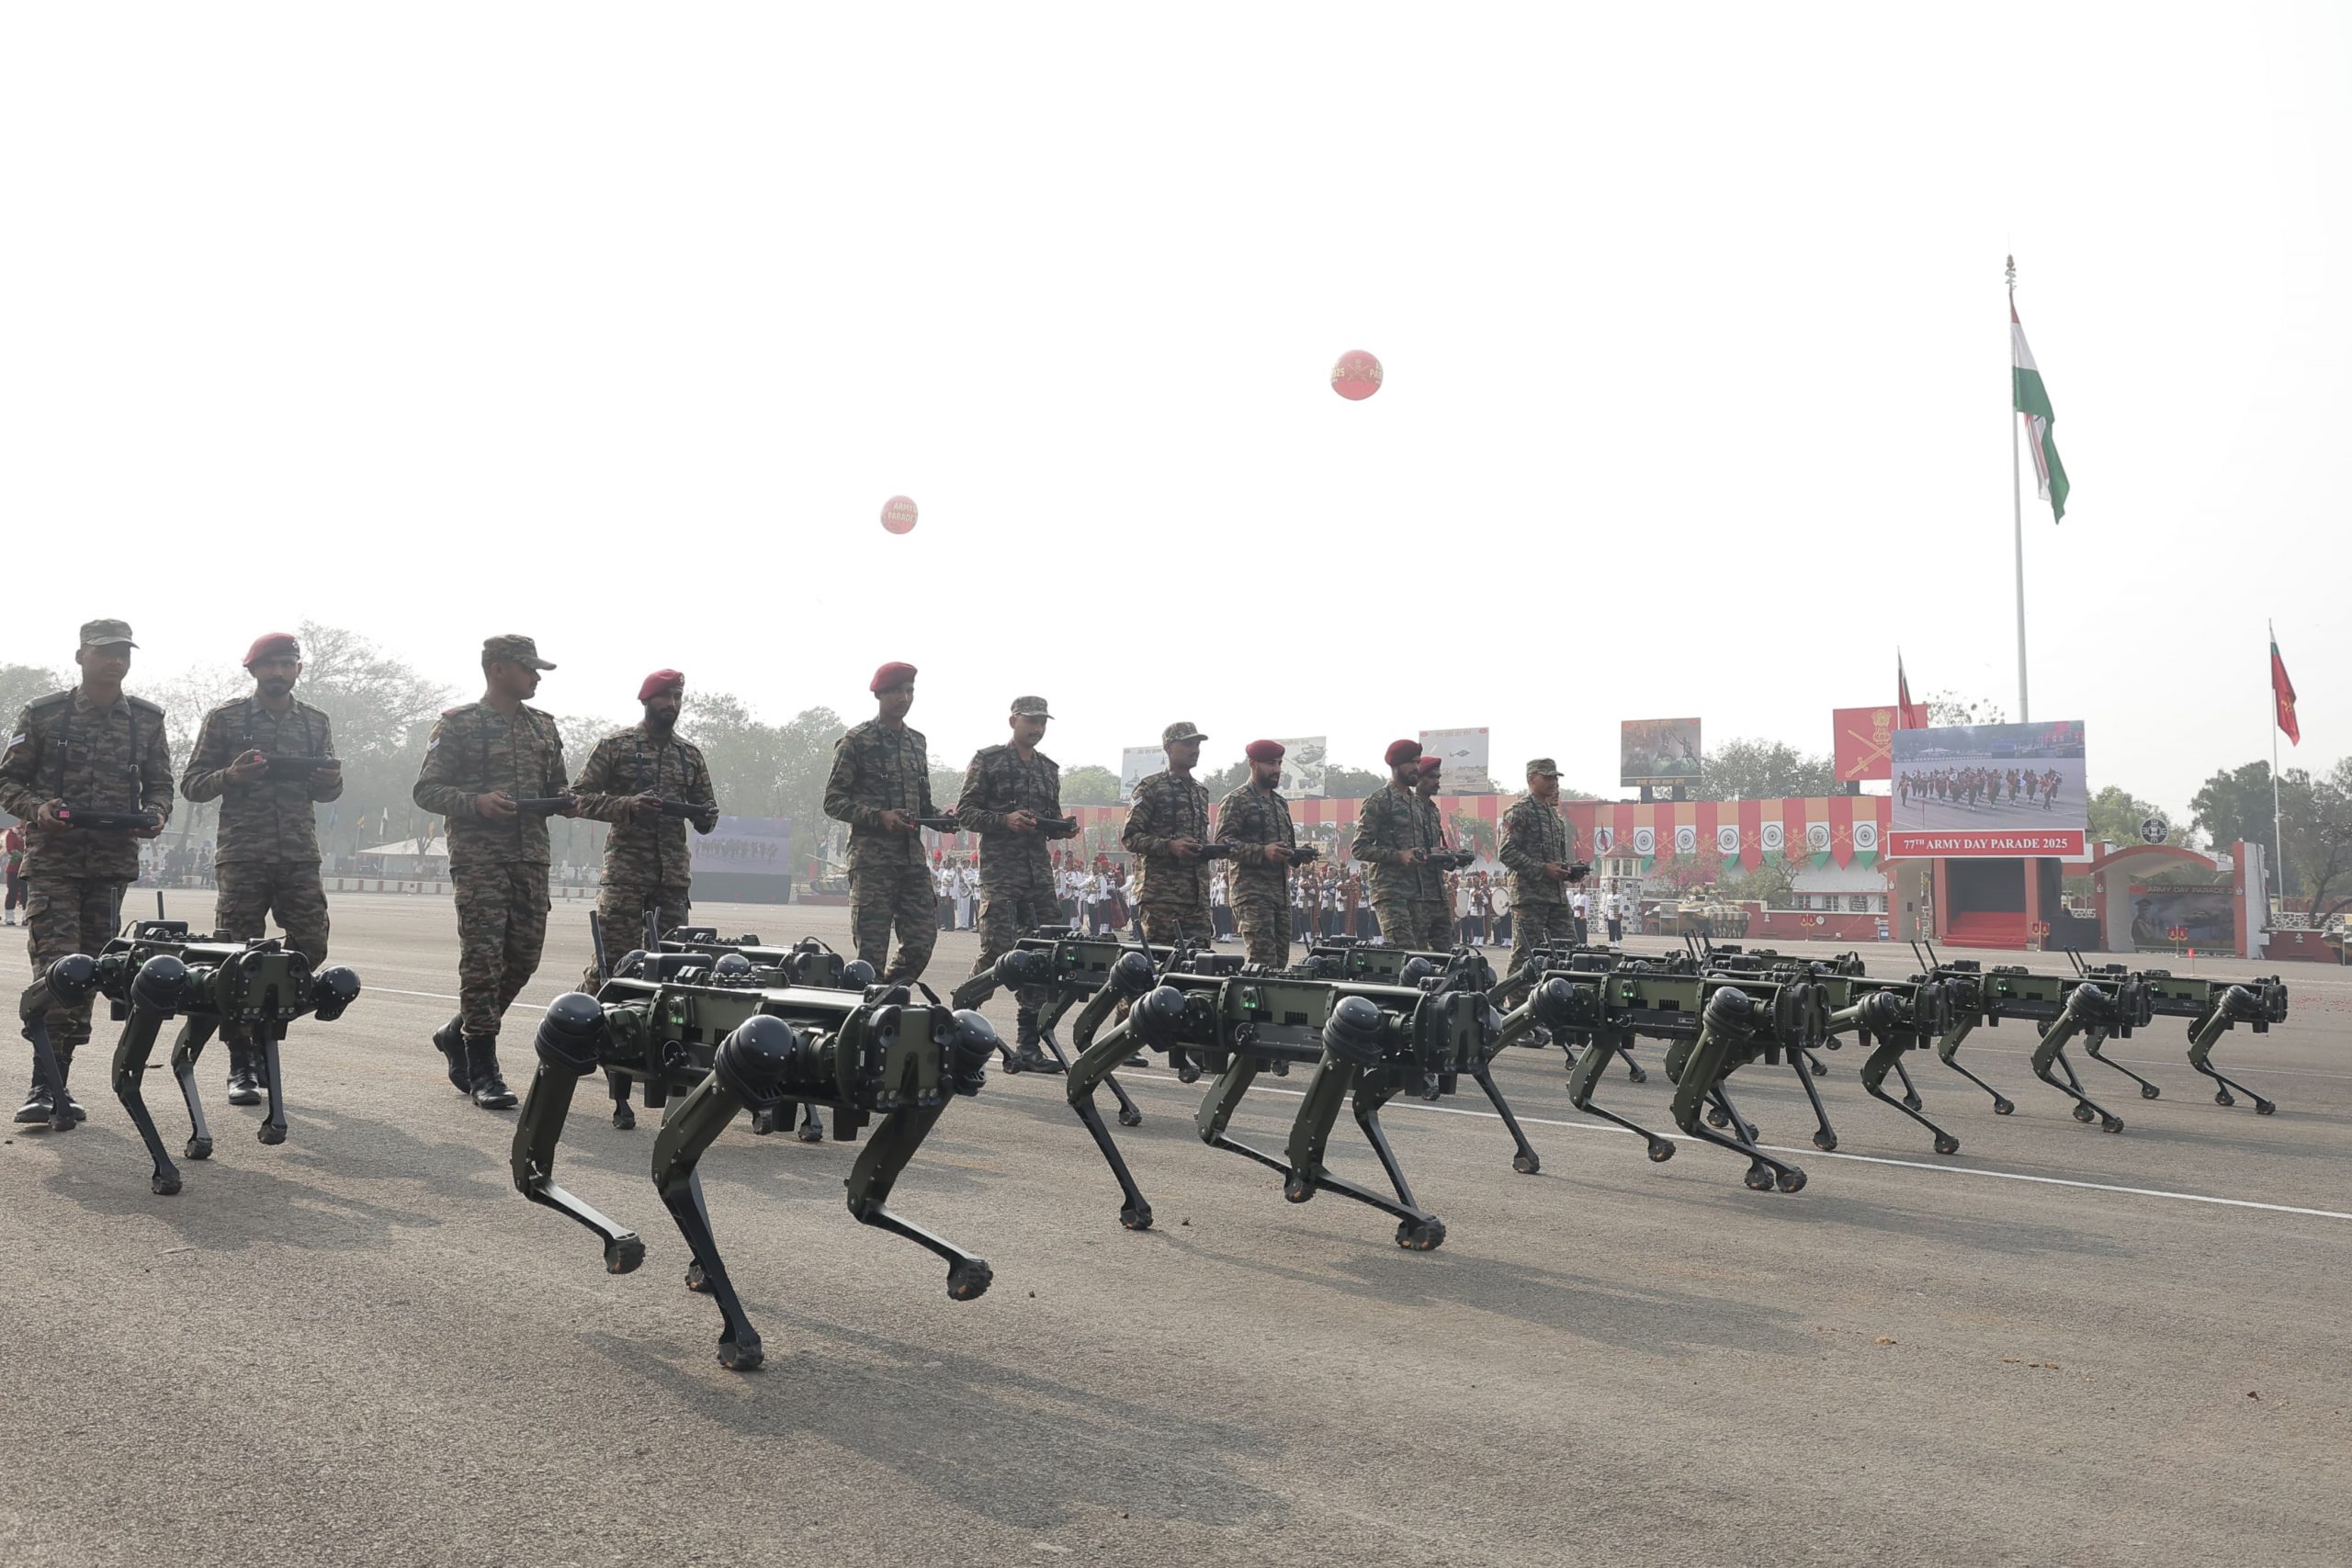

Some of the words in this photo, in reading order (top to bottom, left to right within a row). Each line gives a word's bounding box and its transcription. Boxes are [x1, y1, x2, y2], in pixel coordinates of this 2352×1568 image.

[893, 502, 912, 512] ARMY
[888, 512, 914, 522] PARADE
[1904, 839, 1925, 850] 77TH
[1926, 839, 1962, 850] ARMY
[1963, 839, 1988, 850] DAY
[1991, 838, 2041, 849] PARADE
[2042, 838, 2068, 849] 2025
